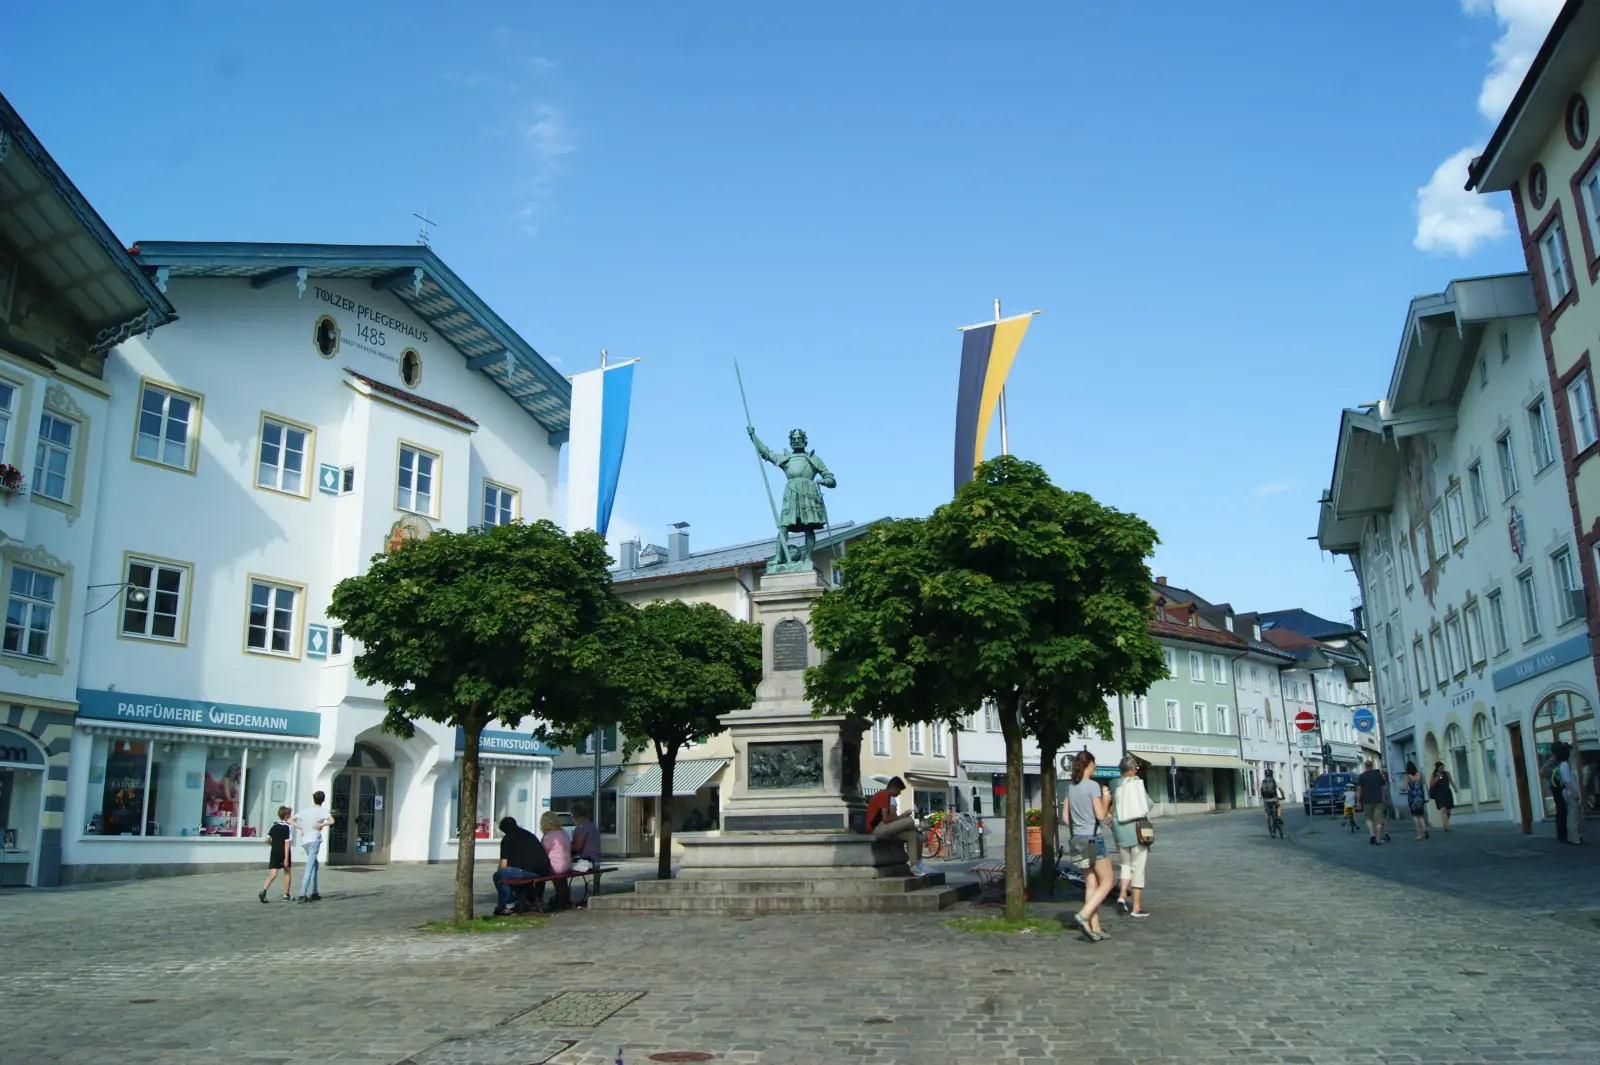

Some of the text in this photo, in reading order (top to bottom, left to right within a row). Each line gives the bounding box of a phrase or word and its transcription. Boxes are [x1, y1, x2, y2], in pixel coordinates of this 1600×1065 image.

[357, 304, 428, 343] PFLEGERHAUS
[357, 323, 386, 346] 1485
[118, 702, 287, 730] PARFÜMERIE WIEDEMANN
[479, 736, 540, 751] SMETIKSTUDIO
